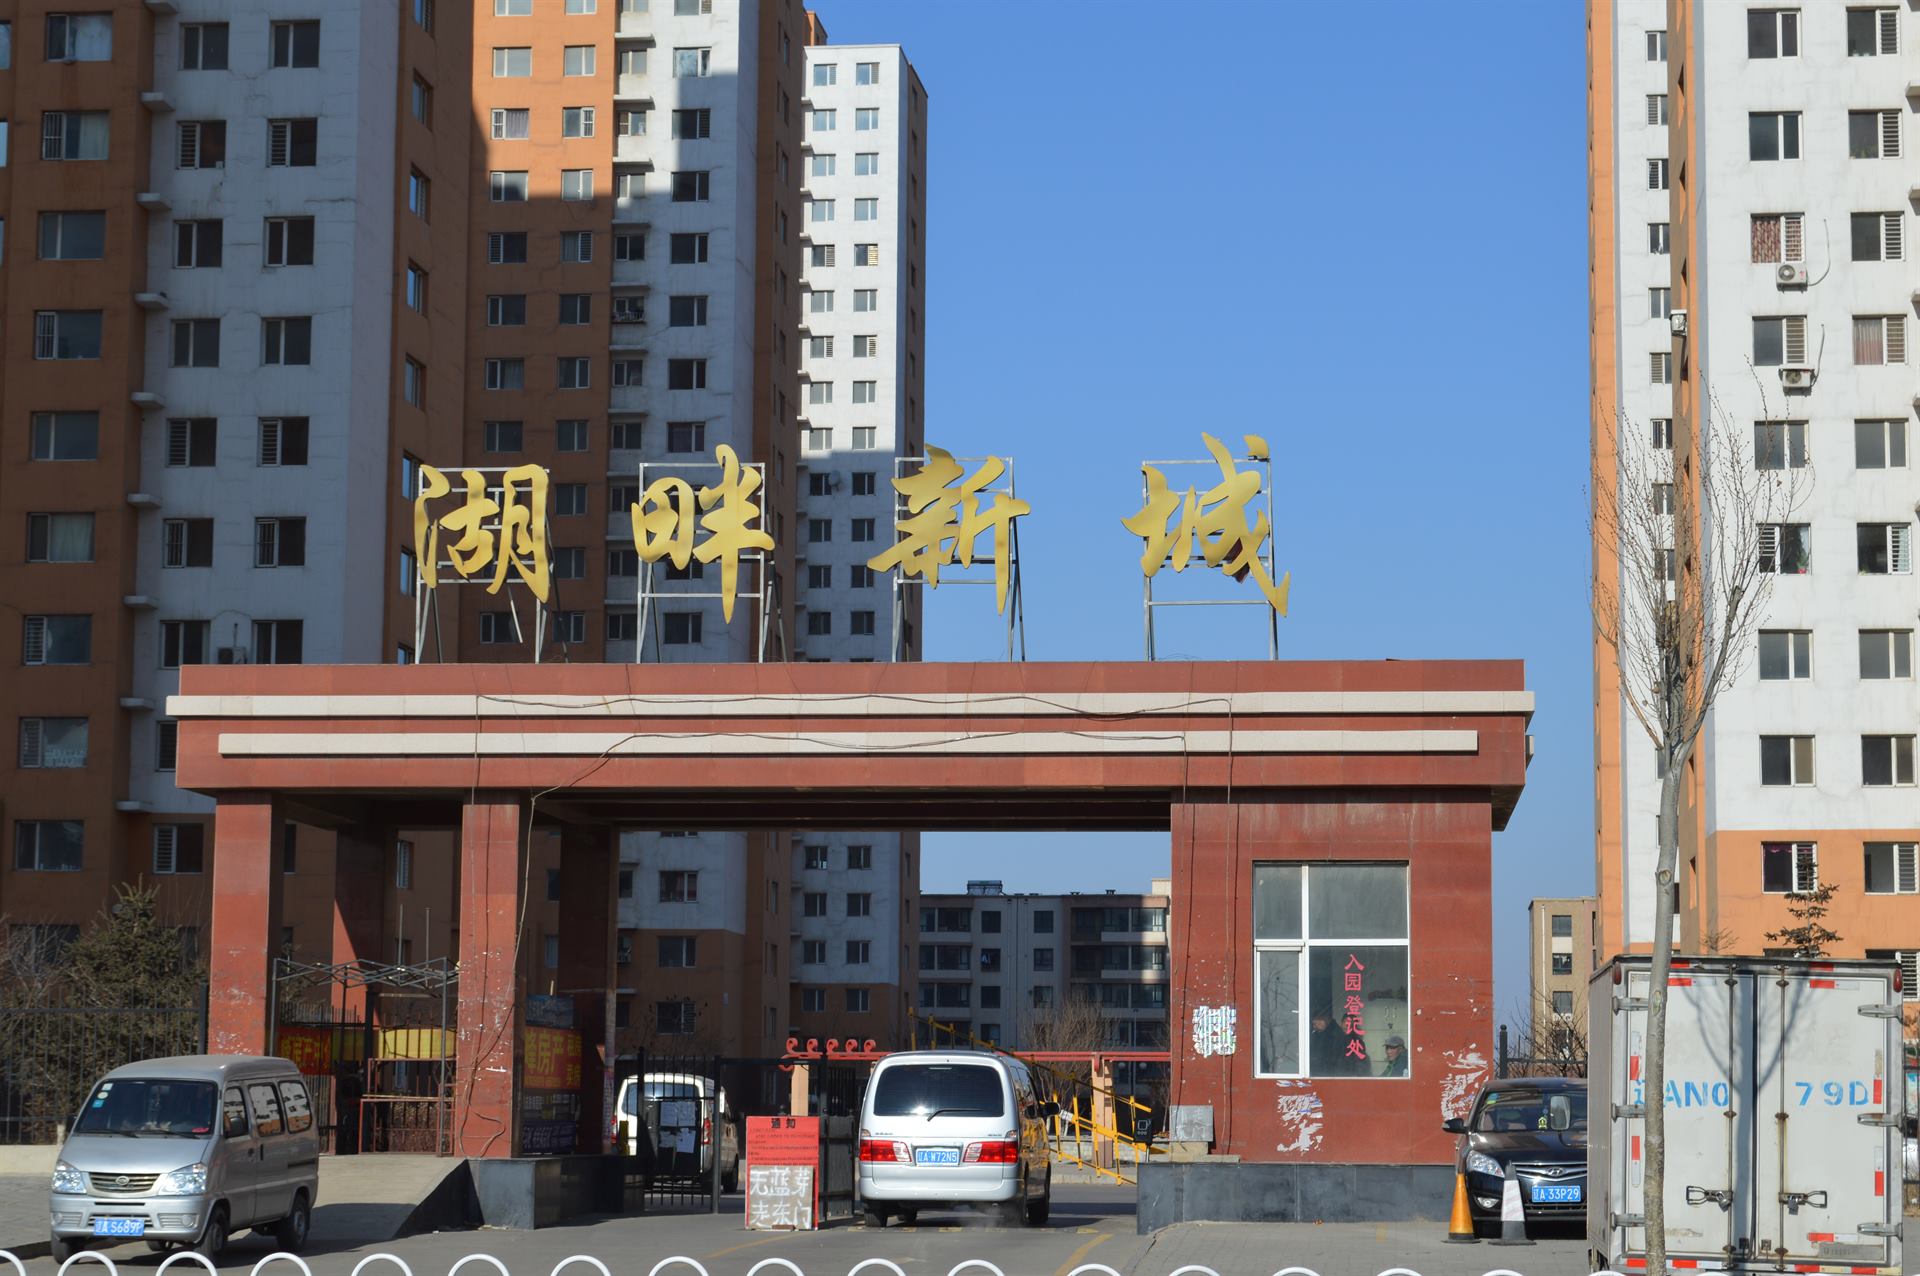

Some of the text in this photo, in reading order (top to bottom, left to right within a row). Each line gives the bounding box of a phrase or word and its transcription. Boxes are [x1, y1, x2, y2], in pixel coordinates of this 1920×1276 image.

[414, 431, 1291, 625] 湖畔新城
[1343, 953, 1367, 1060] 入园登记处
[1795, 1080, 1869, 1106] 79D
[771, 1118, 796, 1129] 通知
[750, 1167, 812, 1197] 无蓝芽
[751, 1200, 811, 1229] 走东门
